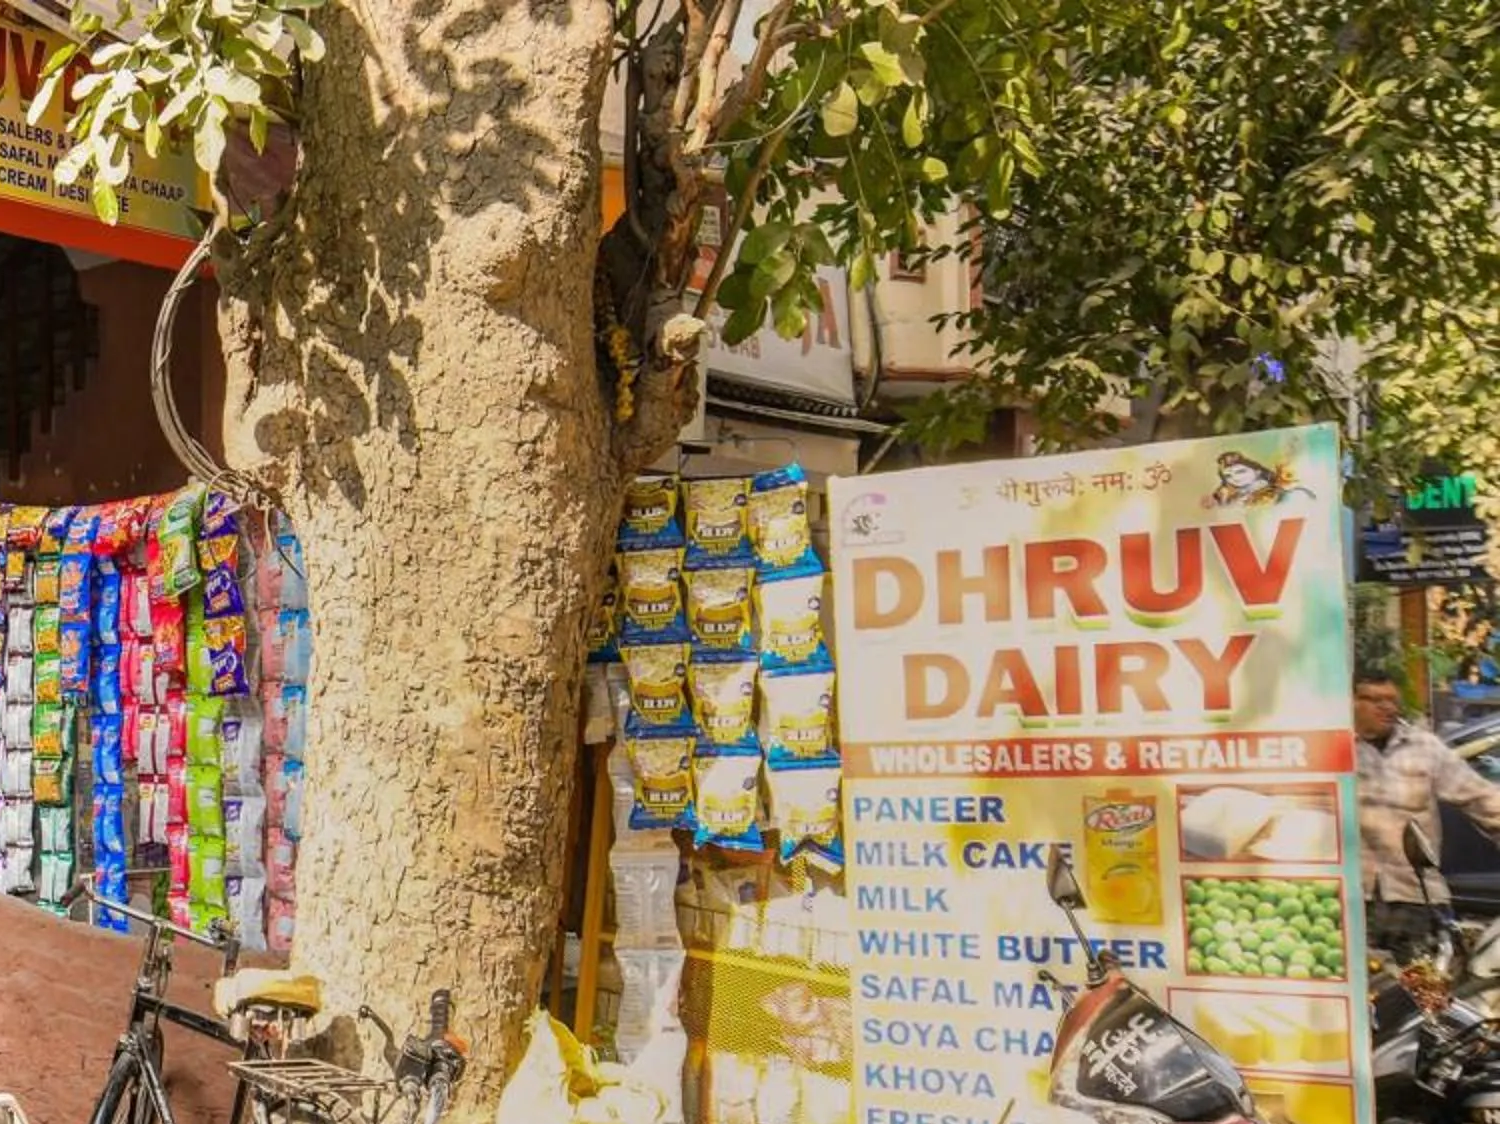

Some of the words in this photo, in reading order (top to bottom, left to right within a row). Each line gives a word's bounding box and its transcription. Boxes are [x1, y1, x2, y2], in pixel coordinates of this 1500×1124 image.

[0, 144, 43, 169] SAFAL
[57, 133, 66, 149] &
[59, 184, 89, 202] DESI
[852, 518, 1304, 632] DHRUV
[903, 635, 1257, 722] DAIRY
[871, 743, 1093, 773] WHOLESALERS
[1104, 744, 1127, 769] &
[1139, 737, 1308, 770] RETAILER
[854, 796, 1006, 824] PANEER
[856, 841, 948, 868] MILK
[858, 885, 949, 912] MILK
[859, 930, 980, 961] WHITE
[998, 936, 1167, 969] BUTTER
[861, 975, 976, 1005] SAFAL
[994, 982, 1076, 1011] MAT
[862, 1019, 960, 1050] SOYA
[975, 1027, 1054, 1057] CHA
[865, 1065, 995, 1098] KHOYA
